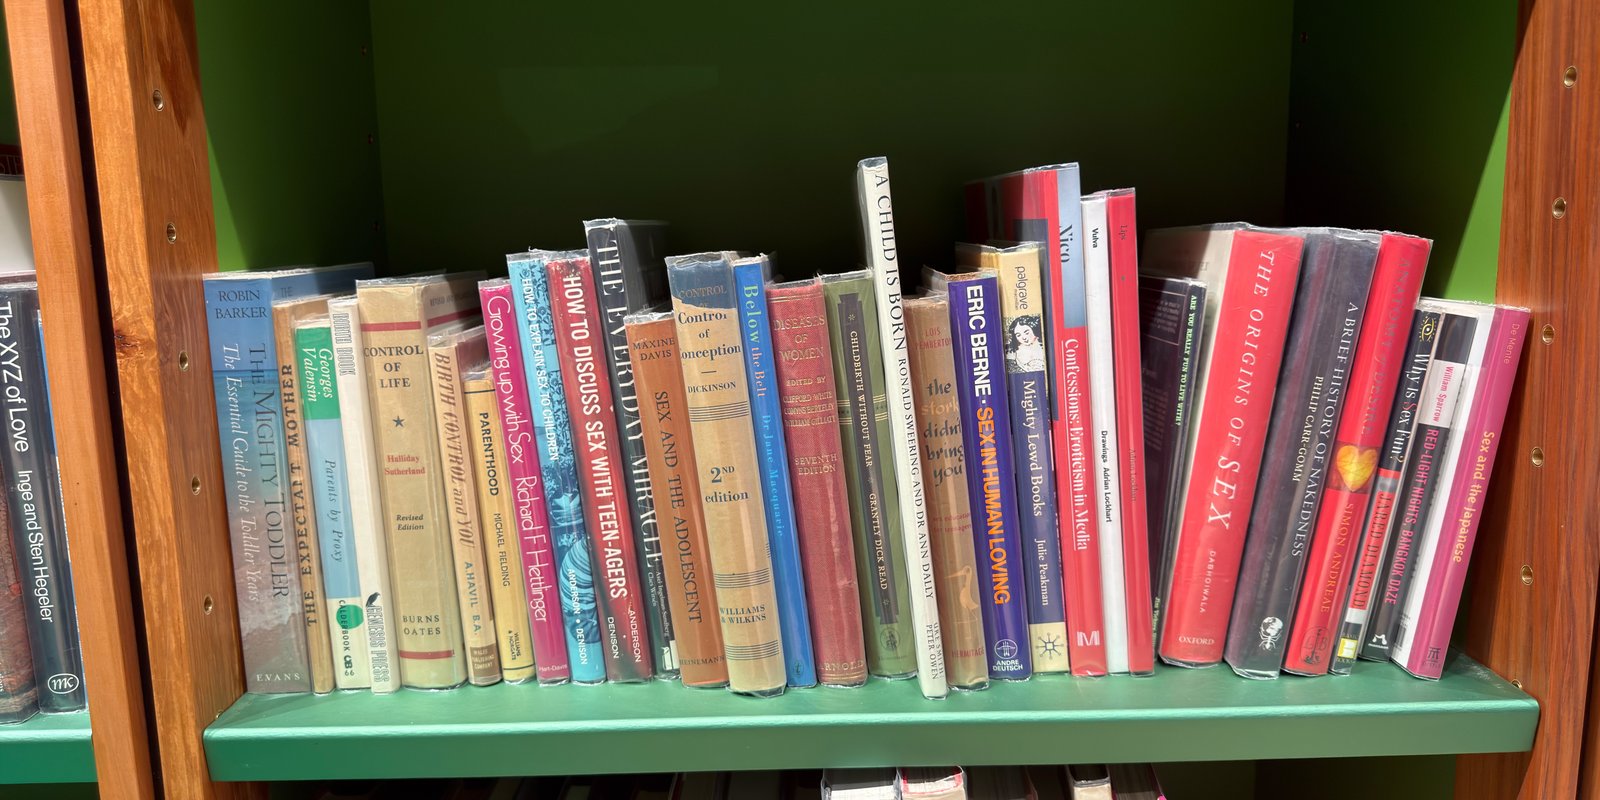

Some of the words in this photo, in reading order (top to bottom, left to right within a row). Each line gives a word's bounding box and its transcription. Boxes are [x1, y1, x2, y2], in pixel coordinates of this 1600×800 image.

[875, 174, 889, 188] A
[877, 195, 897, 261] CHILD
[1091, 227, 1099, 248] Vulva
[596, 239, 625, 296] THE
[886, 268, 899, 287] IS
[1253, 250, 1275, 297] THE
[218, 290, 260, 302] ROBIN
[521, 278, 537, 307] HOW
[562, 276, 586, 315] HOW
[1014, 266, 1028, 310] palgrave
[0, 301, 14, 339] The
[215, 307, 268, 319] BARKER
[526, 307, 537, 322] TO
[743, 285, 761, 344] Below
[773, 315, 825, 331] DISEASES
[888, 294, 907, 351] BORN
[966, 285, 987, 330] ERIC
[1347, 302, 1359, 313] A
[488, 295, 512, 370] Growing
[529, 323, 545, 370] EXPLAIN
[570, 318, 590, 341] TO
[633, 337, 675, 350] MAXINE
[698, 329, 710, 338] of
[794, 334, 809, 344] OF
[1339, 319, 1356, 365] BRIEF
[1510, 323, 1521, 335] De
[0, 341, 23, 384] XYZ
[249, 343, 268, 385] THE
[364, 345, 424, 357] CONTROL
[383, 362, 401, 372] OF
[640, 350, 672, 361] DAVIS
[751, 347, 763, 368] the
[779, 346, 824, 362] WOMEN
[850, 331, 864, 391] CHILDBIRTH
[971, 334, 992, 398] BERNE
[1234, 309, 1264, 406] ORIGINS
[1504, 337, 1517, 365] Mente
[302, 347, 318, 402] Valensin
[318, 348, 334, 399] Georges
[380, 377, 411, 388] LIFE
[435, 352, 456, 408] BIRTH
[497, 371, 514, 394] up
[536, 371, 548, 389] SEX
[574, 346, 600, 416] DISCUSS
[607, 305, 643, 442] EVERYDAY
[687, 381, 736, 394] DICKINSON
[753, 371, 768, 398] Belt
[899, 358, 912, 410] RONALD
[927, 379, 952, 397] the
[1064, 338, 1083, 424] Confessions:
[1441, 366, 1454, 392] William
[5, 385, 27, 404] of
[281, 364, 301, 447] MOTHER
[540, 391, 551, 407] TO
[654, 391, 672, 422] SEX
[1021, 380, 1037, 429] Mighty
[1309, 375, 1324, 413] PHILIP
[1320, 366, 1345, 441] HISTORY
[1432, 393, 1447, 423] Sparrow
[9, 407, 29, 452] Love
[503, 395, 528, 432] with
[860, 394, 871, 441] WITHOUT
[977, 407, 996, 446] SEX
[253, 390, 279, 487] MIGHTY
[444, 411, 466, 487] CONTROL
[508, 432, 531, 464] Sex
[542, 406, 560, 461] CHILDREN
[585, 421, 607, 453] SEX
[660, 430, 679, 468] AND
[904, 414, 920, 476] SWEERING
[1100, 430, 1109, 463] Drawings
[1228, 417, 1245, 446] OF
[1292, 413, 1316, 482] CARR-GOMM
[1480, 431, 1495, 453] Sex
[387, 454, 420, 464] Halliday
[795, 454, 837, 466] SEVENTH
[863, 443, 873, 467] FEAR
[981, 447, 998, 466] IN
[1027, 433, 1042, 471] Lewd
[1069, 426, 1087, 492] Eroticism
[1314, 443, 1327, 463] OF
[1416, 428, 1440, 486] RED-LIGHT
[1473, 455, 1487, 482] and
[17, 470, 33, 500] Inge
[325, 460, 339, 503] Parents
[384, 466, 425, 476] Sutherland
[591, 455, 613, 498] WITH
[798, 464, 837, 476] EDITION
[932, 464, 963, 487] you
[453, 488, 468, 516] and
[479, 412, 499, 496] PARENTHOOD
[493, 513, 505, 547] MICHAEL
[499, 550, 511, 587] FIELDING
[668, 475, 685, 509] THE
[705, 490, 749, 503] edition
[912, 479, 924, 507] AND
[983, 467, 1005, 535] HUMAN
[1030, 472, 1043, 517] Books
[1073, 493, 1086, 507] in
[1104, 491, 1113, 523] Lockhart
[1207, 455, 1241, 530] SEX
[1405, 486, 1425, 529] NIGHTS,
[1467, 483, 1484, 504] the
[24, 503, 41, 531] and
[290, 463, 312, 576] EXPECTANT
[330, 509, 342, 522] by
[396, 514, 424, 522] Revised
[397, 523, 424, 531] Edition
[630, 454, 662, 568] MIRACLE
[869, 493, 881, 537] GRANTLY
[916, 511, 926, 529] DR
[1292, 467, 1320, 557] NAKEDNESS
[1331, 503, 1354, 546] SIMON
[1371, 493, 1392, 540] JARED
[264, 491, 290, 598] TODDLER
[330, 529, 344, 563] Proxy
[457, 517, 475, 549] YOU
[918, 532, 929, 559] ANN
[1075, 508, 1091, 551] Media
[1453, 505, 1477, 563] Japanese
[28, 532, 44, 568] Sten
[597, 500, 628, 599] TEEN-AGERS
[874, 537, 884, 564] DICK
[1034, 538, 1046, 560] Julie
[1391, 529, 1414, 577] BANGKOK
[674, 516, 703, 623] ADOLESCENT
[878, 565, 888, 590] READ
[922, 562, 934, 599] DALLY
[988, 538, 1011, 605] LOVING
[1038, 563, 1050, 606] Peakman
[1199, 549, 1217, 613] DABHOIWALA
[1320, 551, 1341, 613] ANDREAE
[1353, 541, 1380, 609] DIAMOND
[34, 567, 53, 623] Hegeler
[304, 590, 318, 626] THE
[1384, 577, 1401, 606] DAZE
[402, 615, 440, 624] BURNS
[566, 568, 581, 615] ANDERSON
[575, 627, 588, 665] DENISON
[720, 604, 766, 616] WILLIAMS
[403, 627, 441, 636] OATES
[607, 616, 620, 660] DENISON
[628, 609, 642, 663] ANDERSON
[926, 624, 936, 650] PETER
[1178, 635, 1215, 646] OXFORD
[256, 672, 300, 682] EVANS
[930, 653, 939, 680] OWEN
